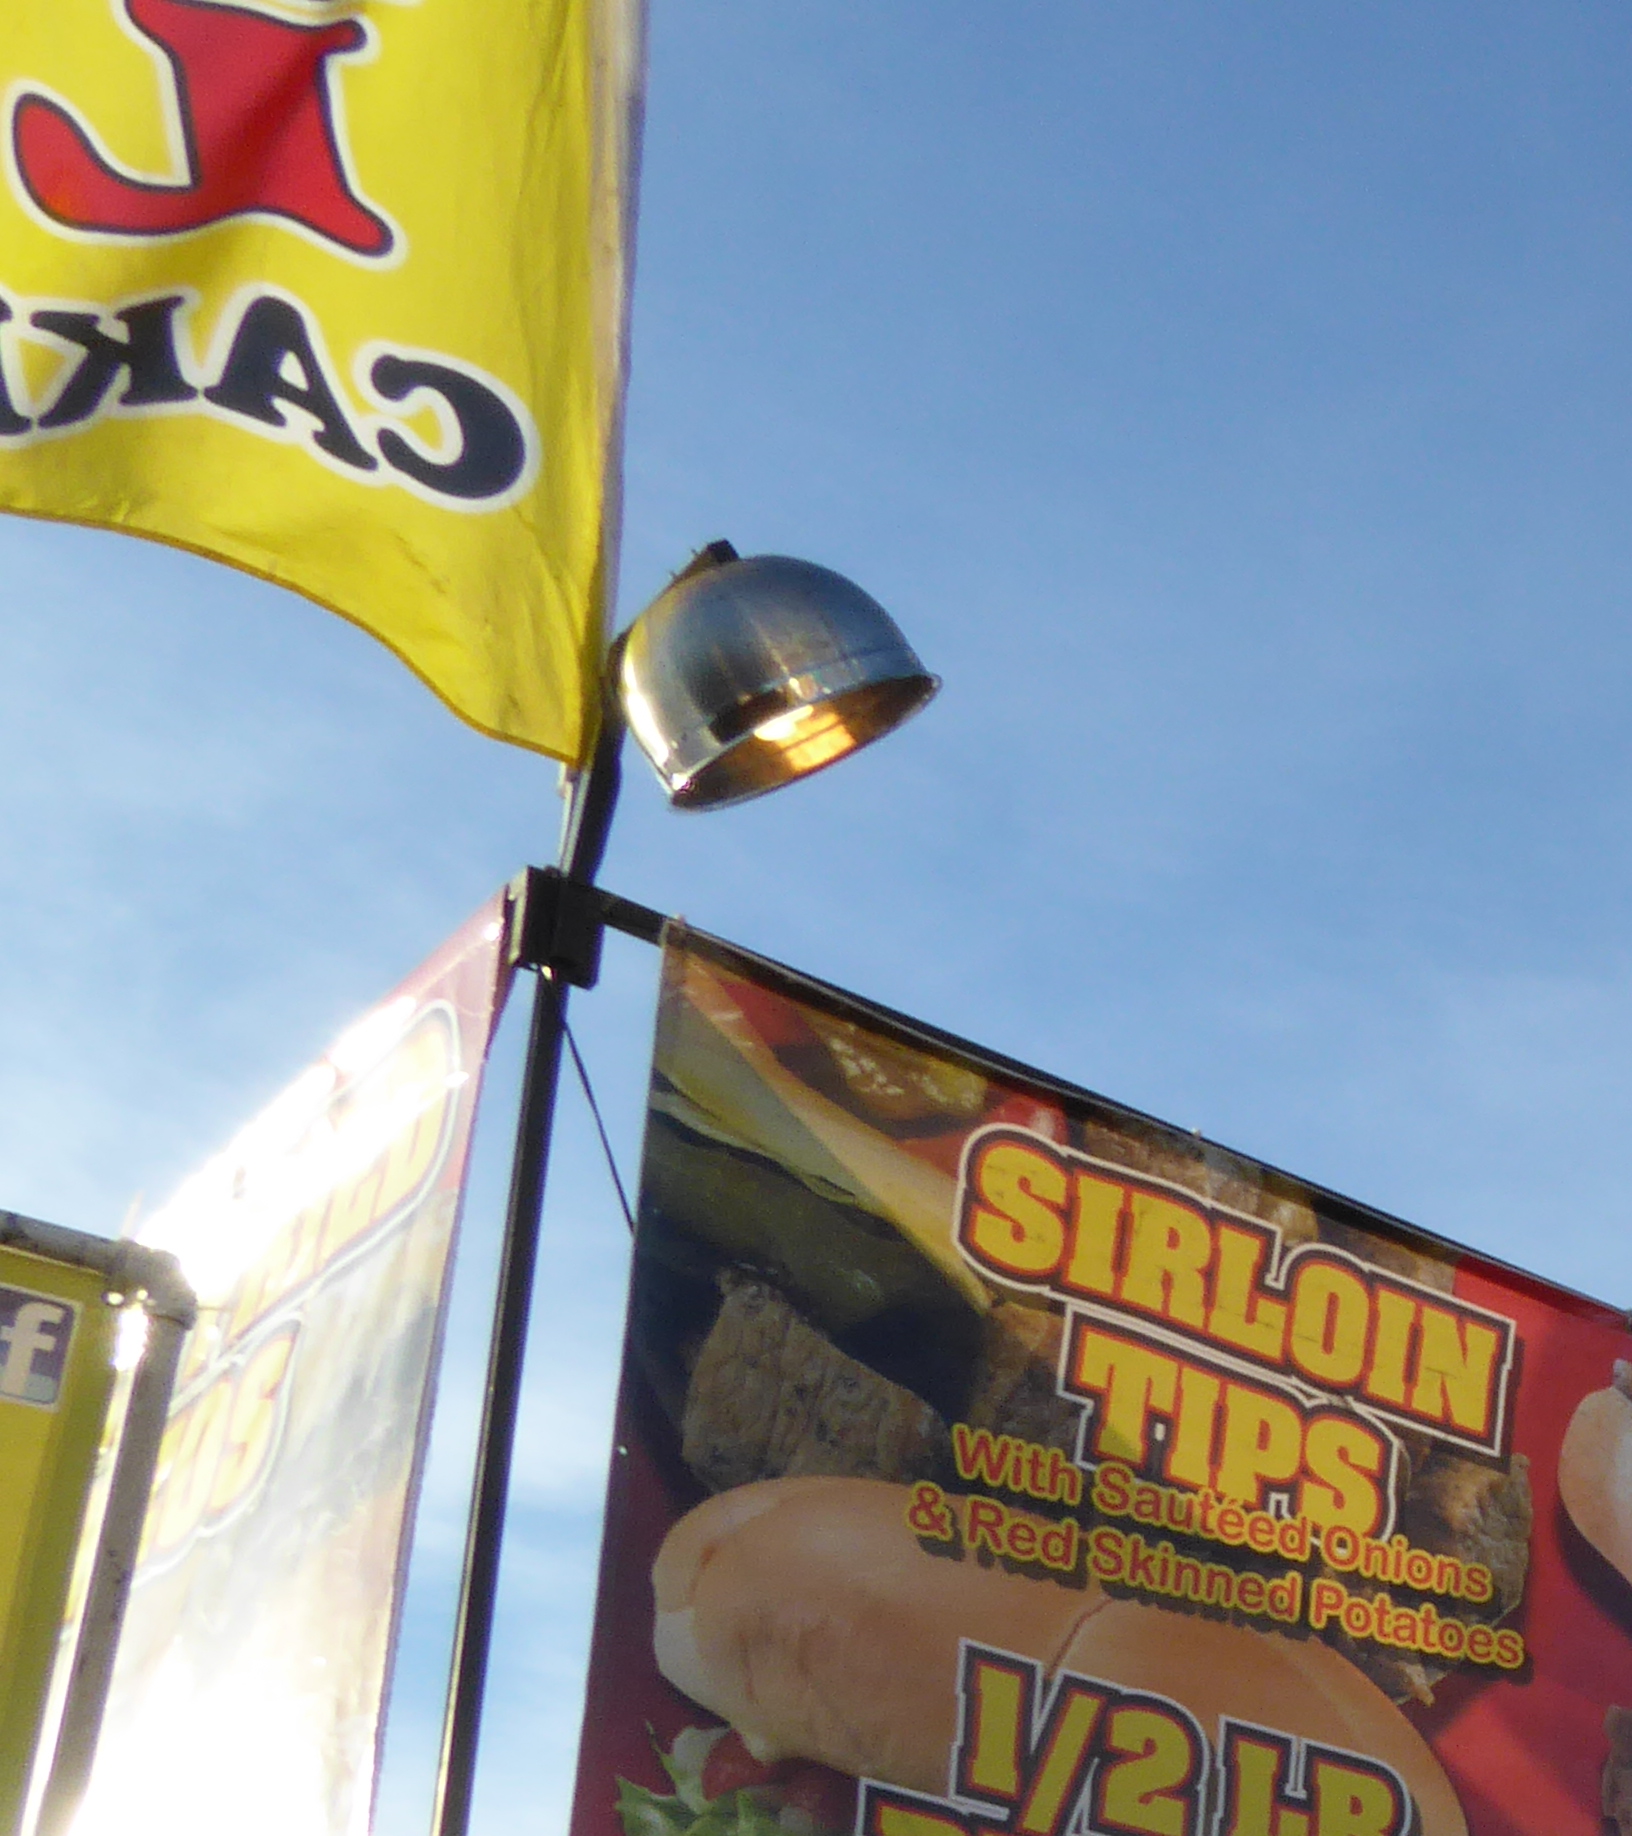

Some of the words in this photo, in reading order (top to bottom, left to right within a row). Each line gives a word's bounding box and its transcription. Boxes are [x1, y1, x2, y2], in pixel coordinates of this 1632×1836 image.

[967, 1140, 1500, 1438] SIRLOIN
[953, 1424, 1080, 1501] With
[1322, 1521, 1494, 1604] Onions
[1074, 1326, 1388, 1543] TIPS
[907, 1481, 950, 1540] &
[966, 1496, 1076, 1573] Red
[1089, 1530, 1300, 1626] Skinned
[1309, 1580, 1526, 1670] Potatoes
